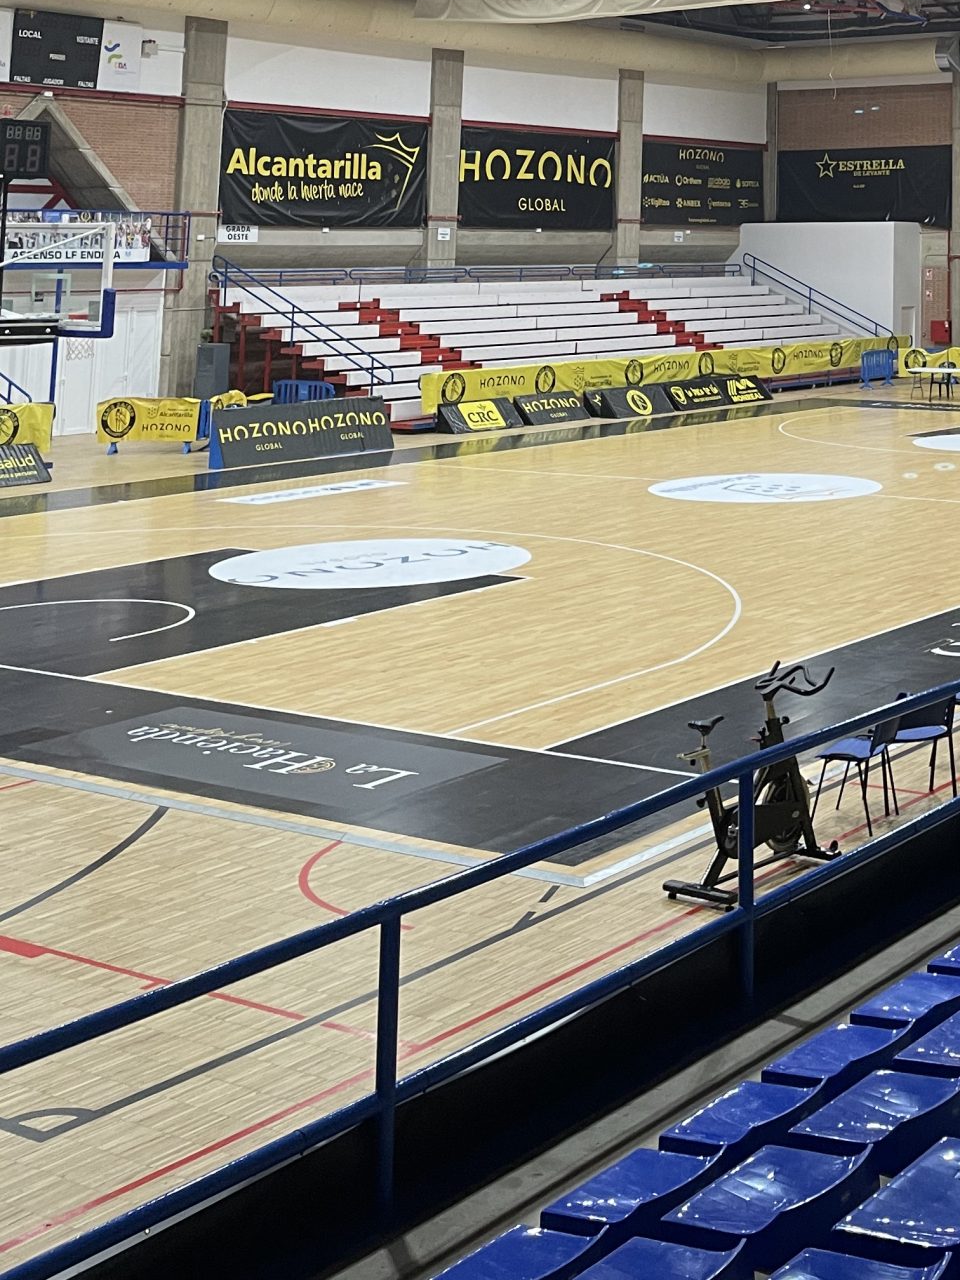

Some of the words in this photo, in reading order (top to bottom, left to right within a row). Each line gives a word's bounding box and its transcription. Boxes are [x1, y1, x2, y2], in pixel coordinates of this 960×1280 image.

[18, 29, 42, 39] LOCAL
[13, 75, 31, 83] FALTAS
[78, 80, 95, 88] FALTAS
[679, 148, 725, 163] HOZONO
[226, 147, 382, 181] Alcantarilla
[459, 148, 612, 188] HOZONO
[838, 158, 905, 171] ESTRELLA
[252, 181, 284, 203] donde
[288, 181, 298, 200] la
[301, 179, 335, 201] huerta
[338, 182, 364, 199] nace
[518, 197, 566, 212] GLOBAL
[65, 250, 78, 259] LF
[80, 250, 121, 259] ENDA
[793, 349, 824, 360] HOZONO
[653, 360, 690, 373] HOZONO
[480, 374, 526, 389] HOZONO
[521, 397, 581, 414] HOZONO
[467, 410, 499, 424] CRC
[142, 423, 191, 433] HOZONO
[218, 420, 307, 444] HOZONO
[308, 411, 386, 434] HOZONO
[340, 431, 365, 441] GLOBAL
[255, 441, 283, 452] GLOBAL
[127, 725, 334, 775] Hacienda
[345, 761, 420, 790] La
